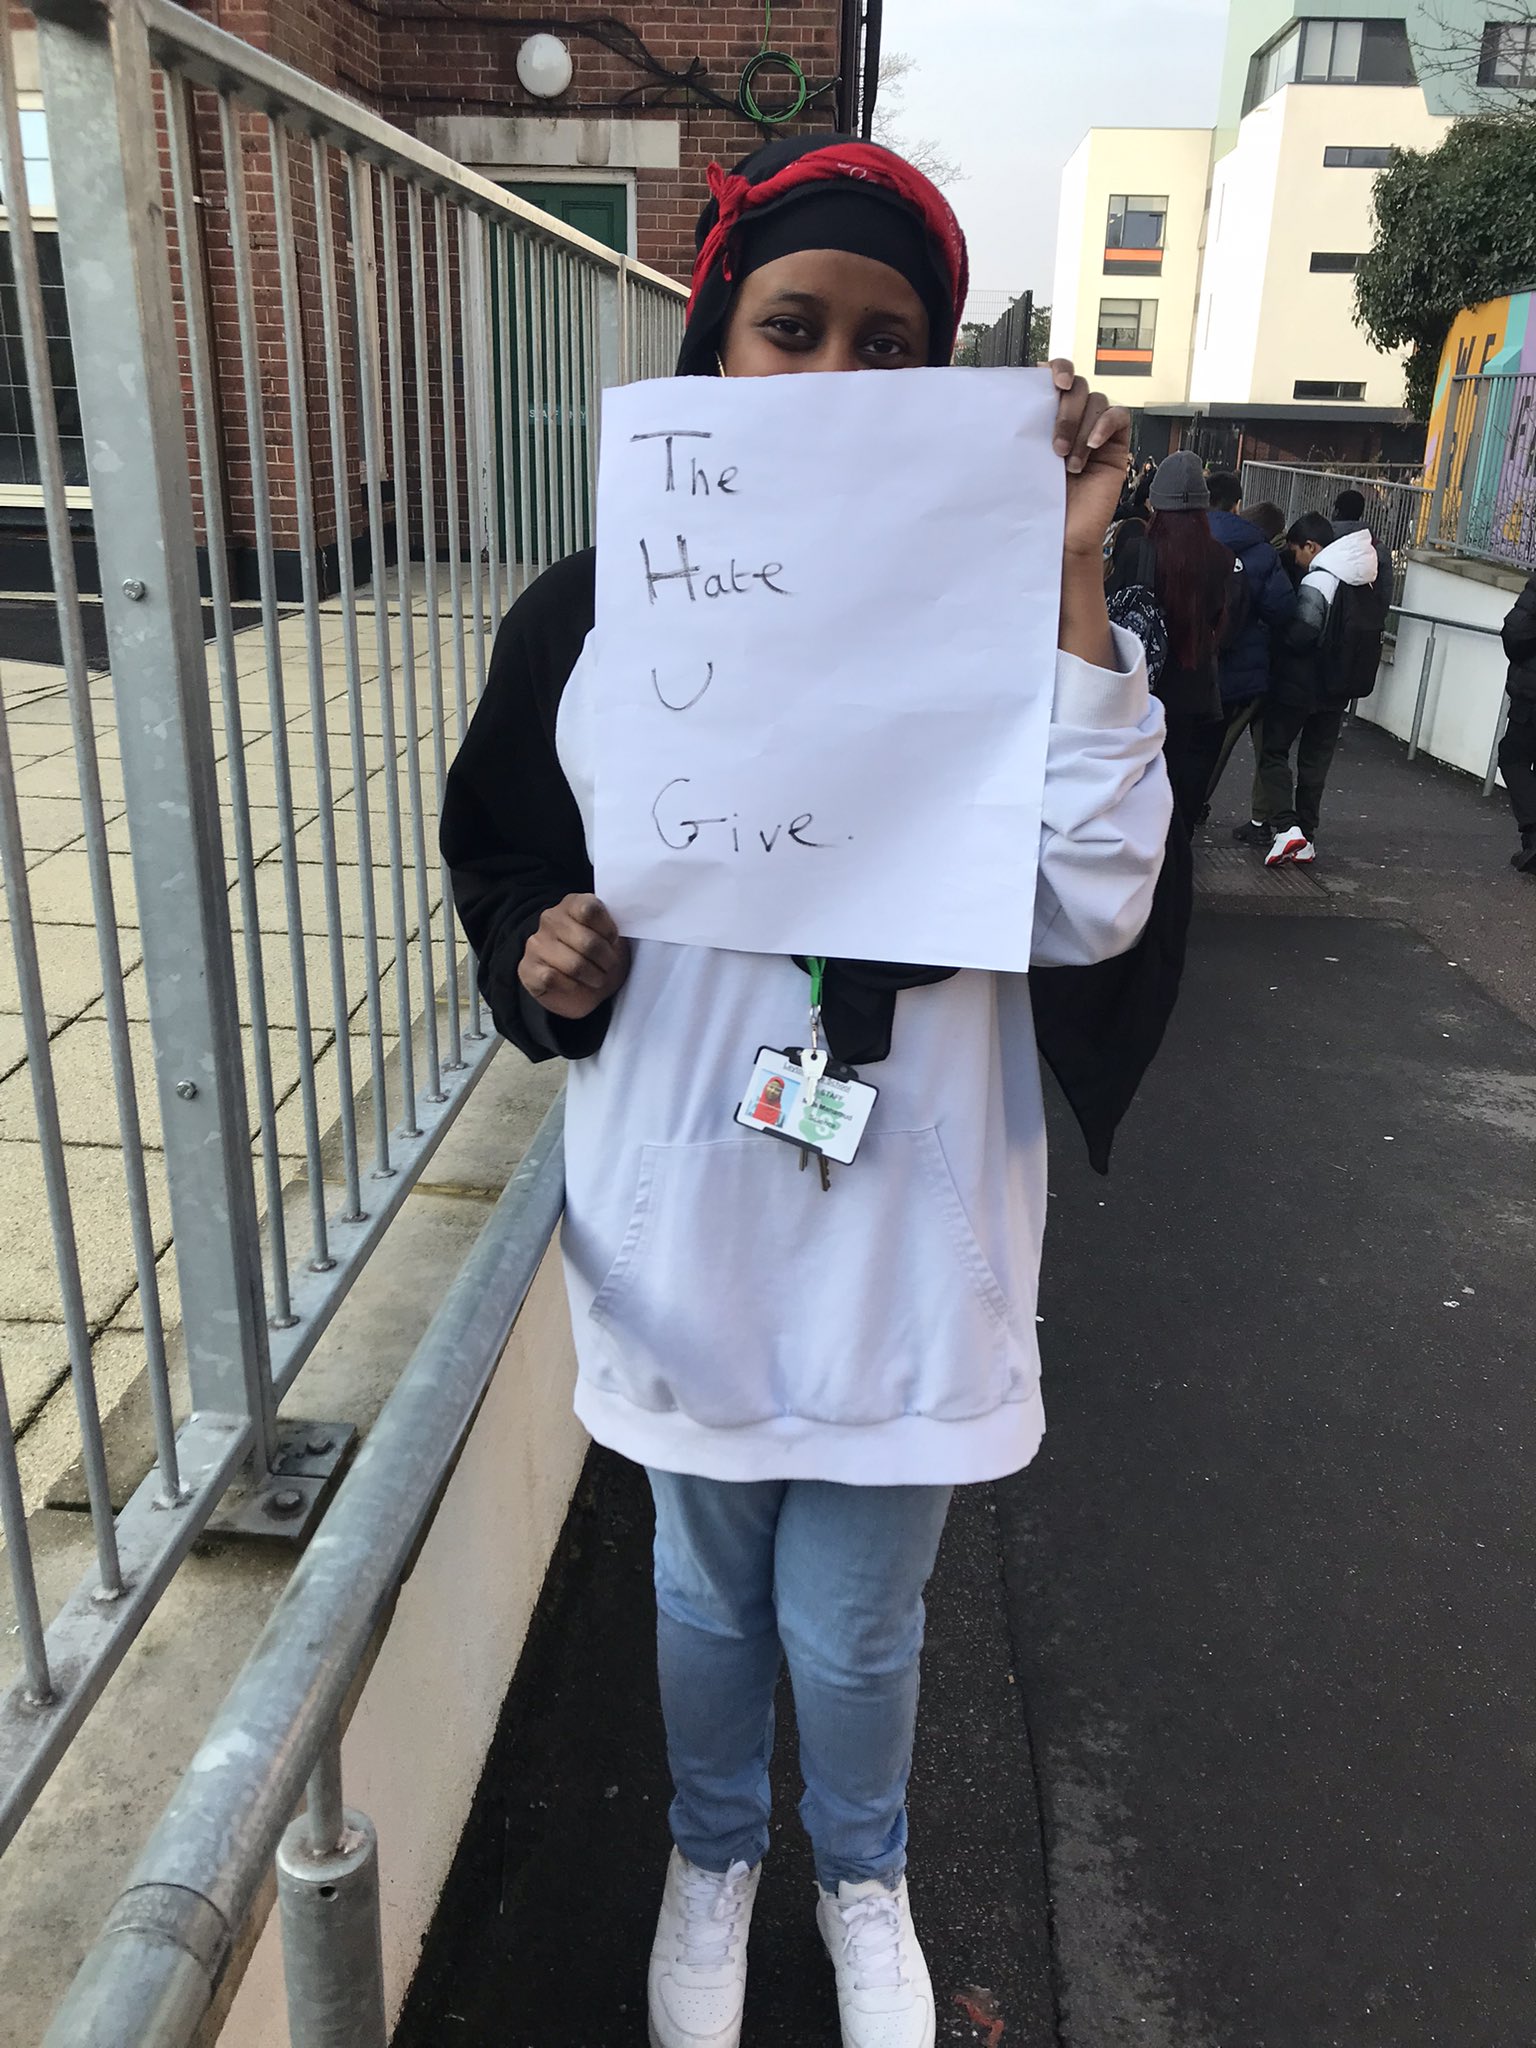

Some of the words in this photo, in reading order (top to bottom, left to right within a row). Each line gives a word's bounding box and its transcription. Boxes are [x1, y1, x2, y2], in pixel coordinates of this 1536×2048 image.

[630, 431, 740, 495] The
[639, 534, 794, 604] Hate
[651, 661, 713, 711] U
